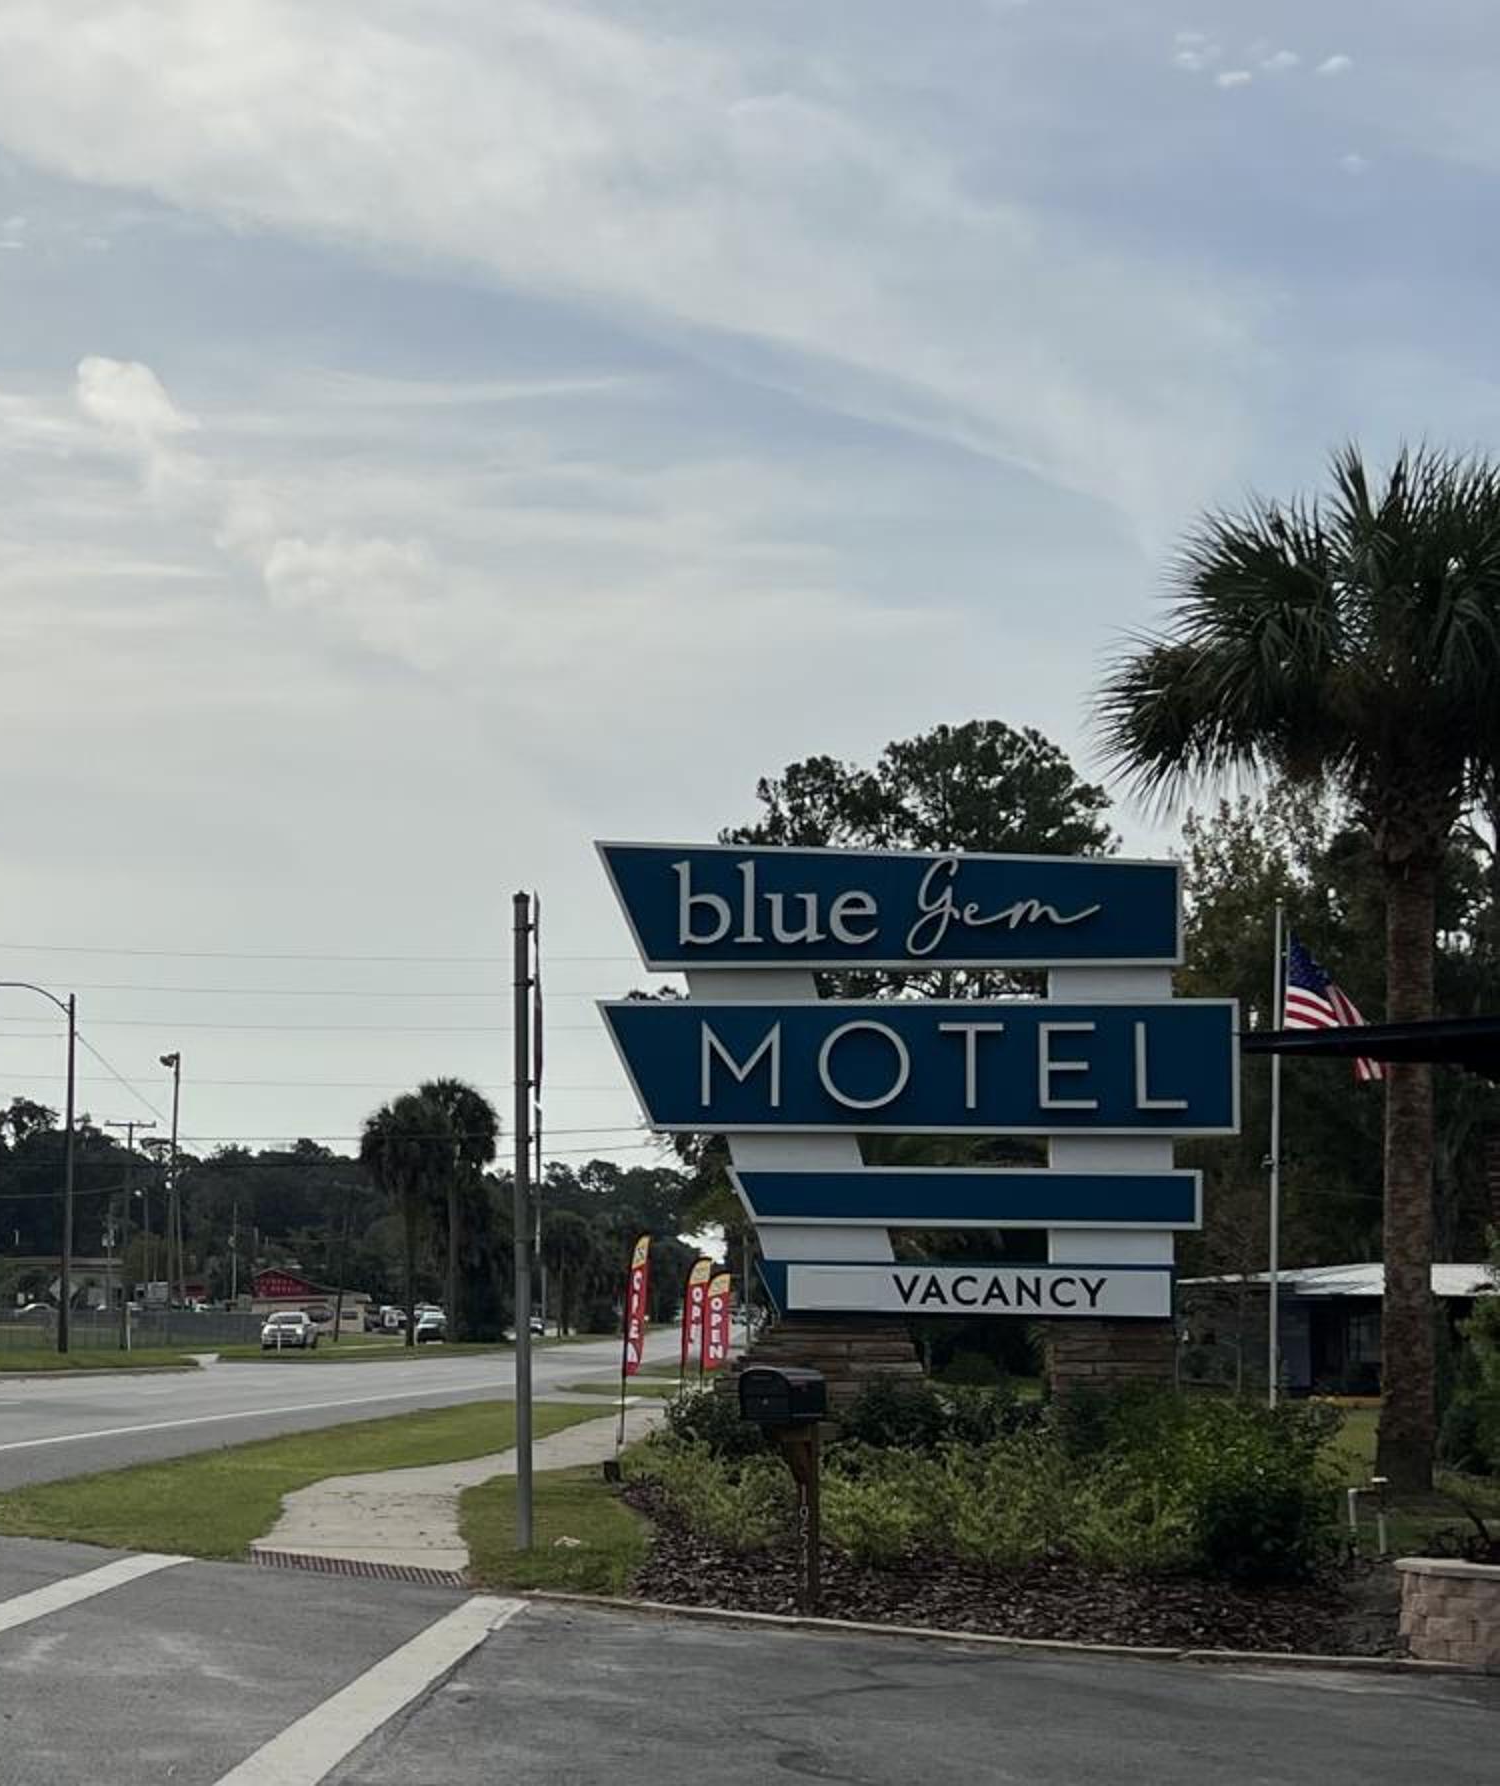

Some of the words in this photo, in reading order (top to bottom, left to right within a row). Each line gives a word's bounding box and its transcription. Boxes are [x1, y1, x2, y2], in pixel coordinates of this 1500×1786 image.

[671, 859, 879, 946] blue
[905, 857, 1100, 956] Gem
[701, 1019, 1189, 1110] MOTEL
[709, 1297, 724, 1359] OPEN
[892, 1274, 1108, 1308] VACANCY
